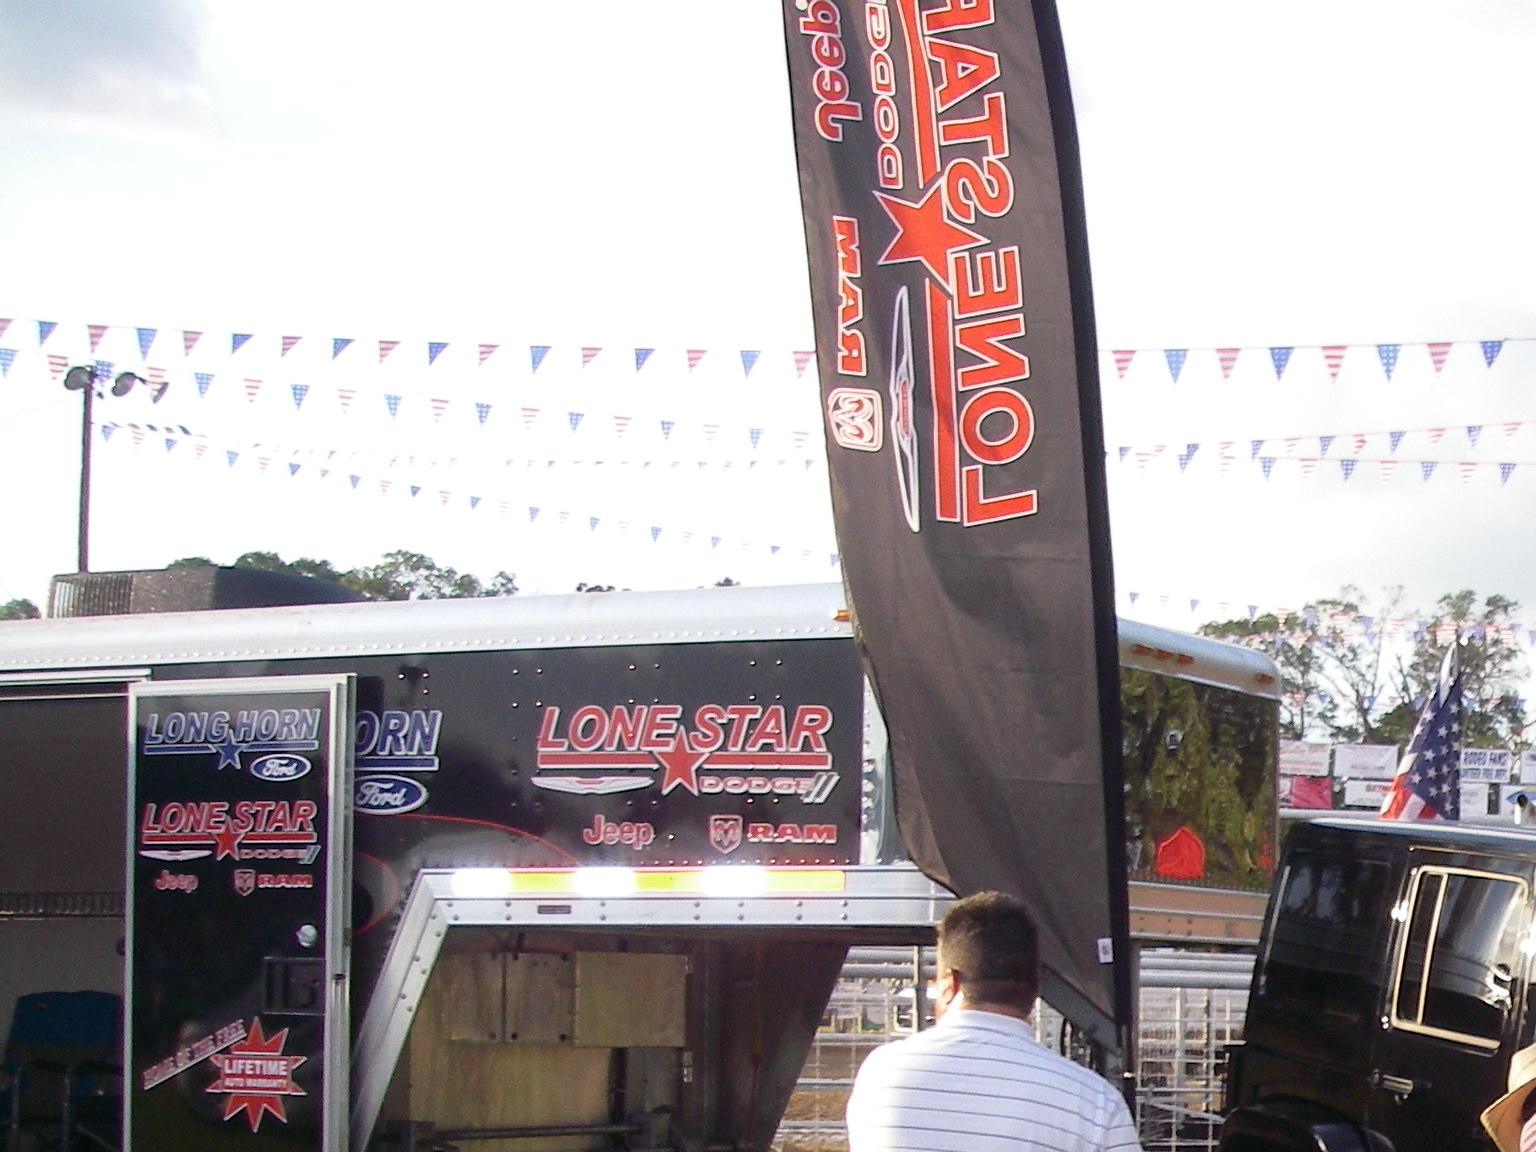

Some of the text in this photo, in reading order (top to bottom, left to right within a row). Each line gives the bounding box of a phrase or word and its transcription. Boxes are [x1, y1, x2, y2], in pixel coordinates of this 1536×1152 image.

[145, 709, 321, 744] LONG HORN
[355, 710, 443, 756] ORN
[537, 705, 833, 752] LONE STAR
[261, 759, 298, 777] Ford
[355, 781, 407, 807] Ford
[700, 776, 816, 795] DODGE
[142, 800, 318, 833] LONE STAR
[582, 814, 654, 851] Jeep
[747, 822, 838, 844] RAM
[155, 869, 199, 893] Jeep
[257, 873, 314, 889] RAM
[224, 1059, 288, 1076] LIFETIME
